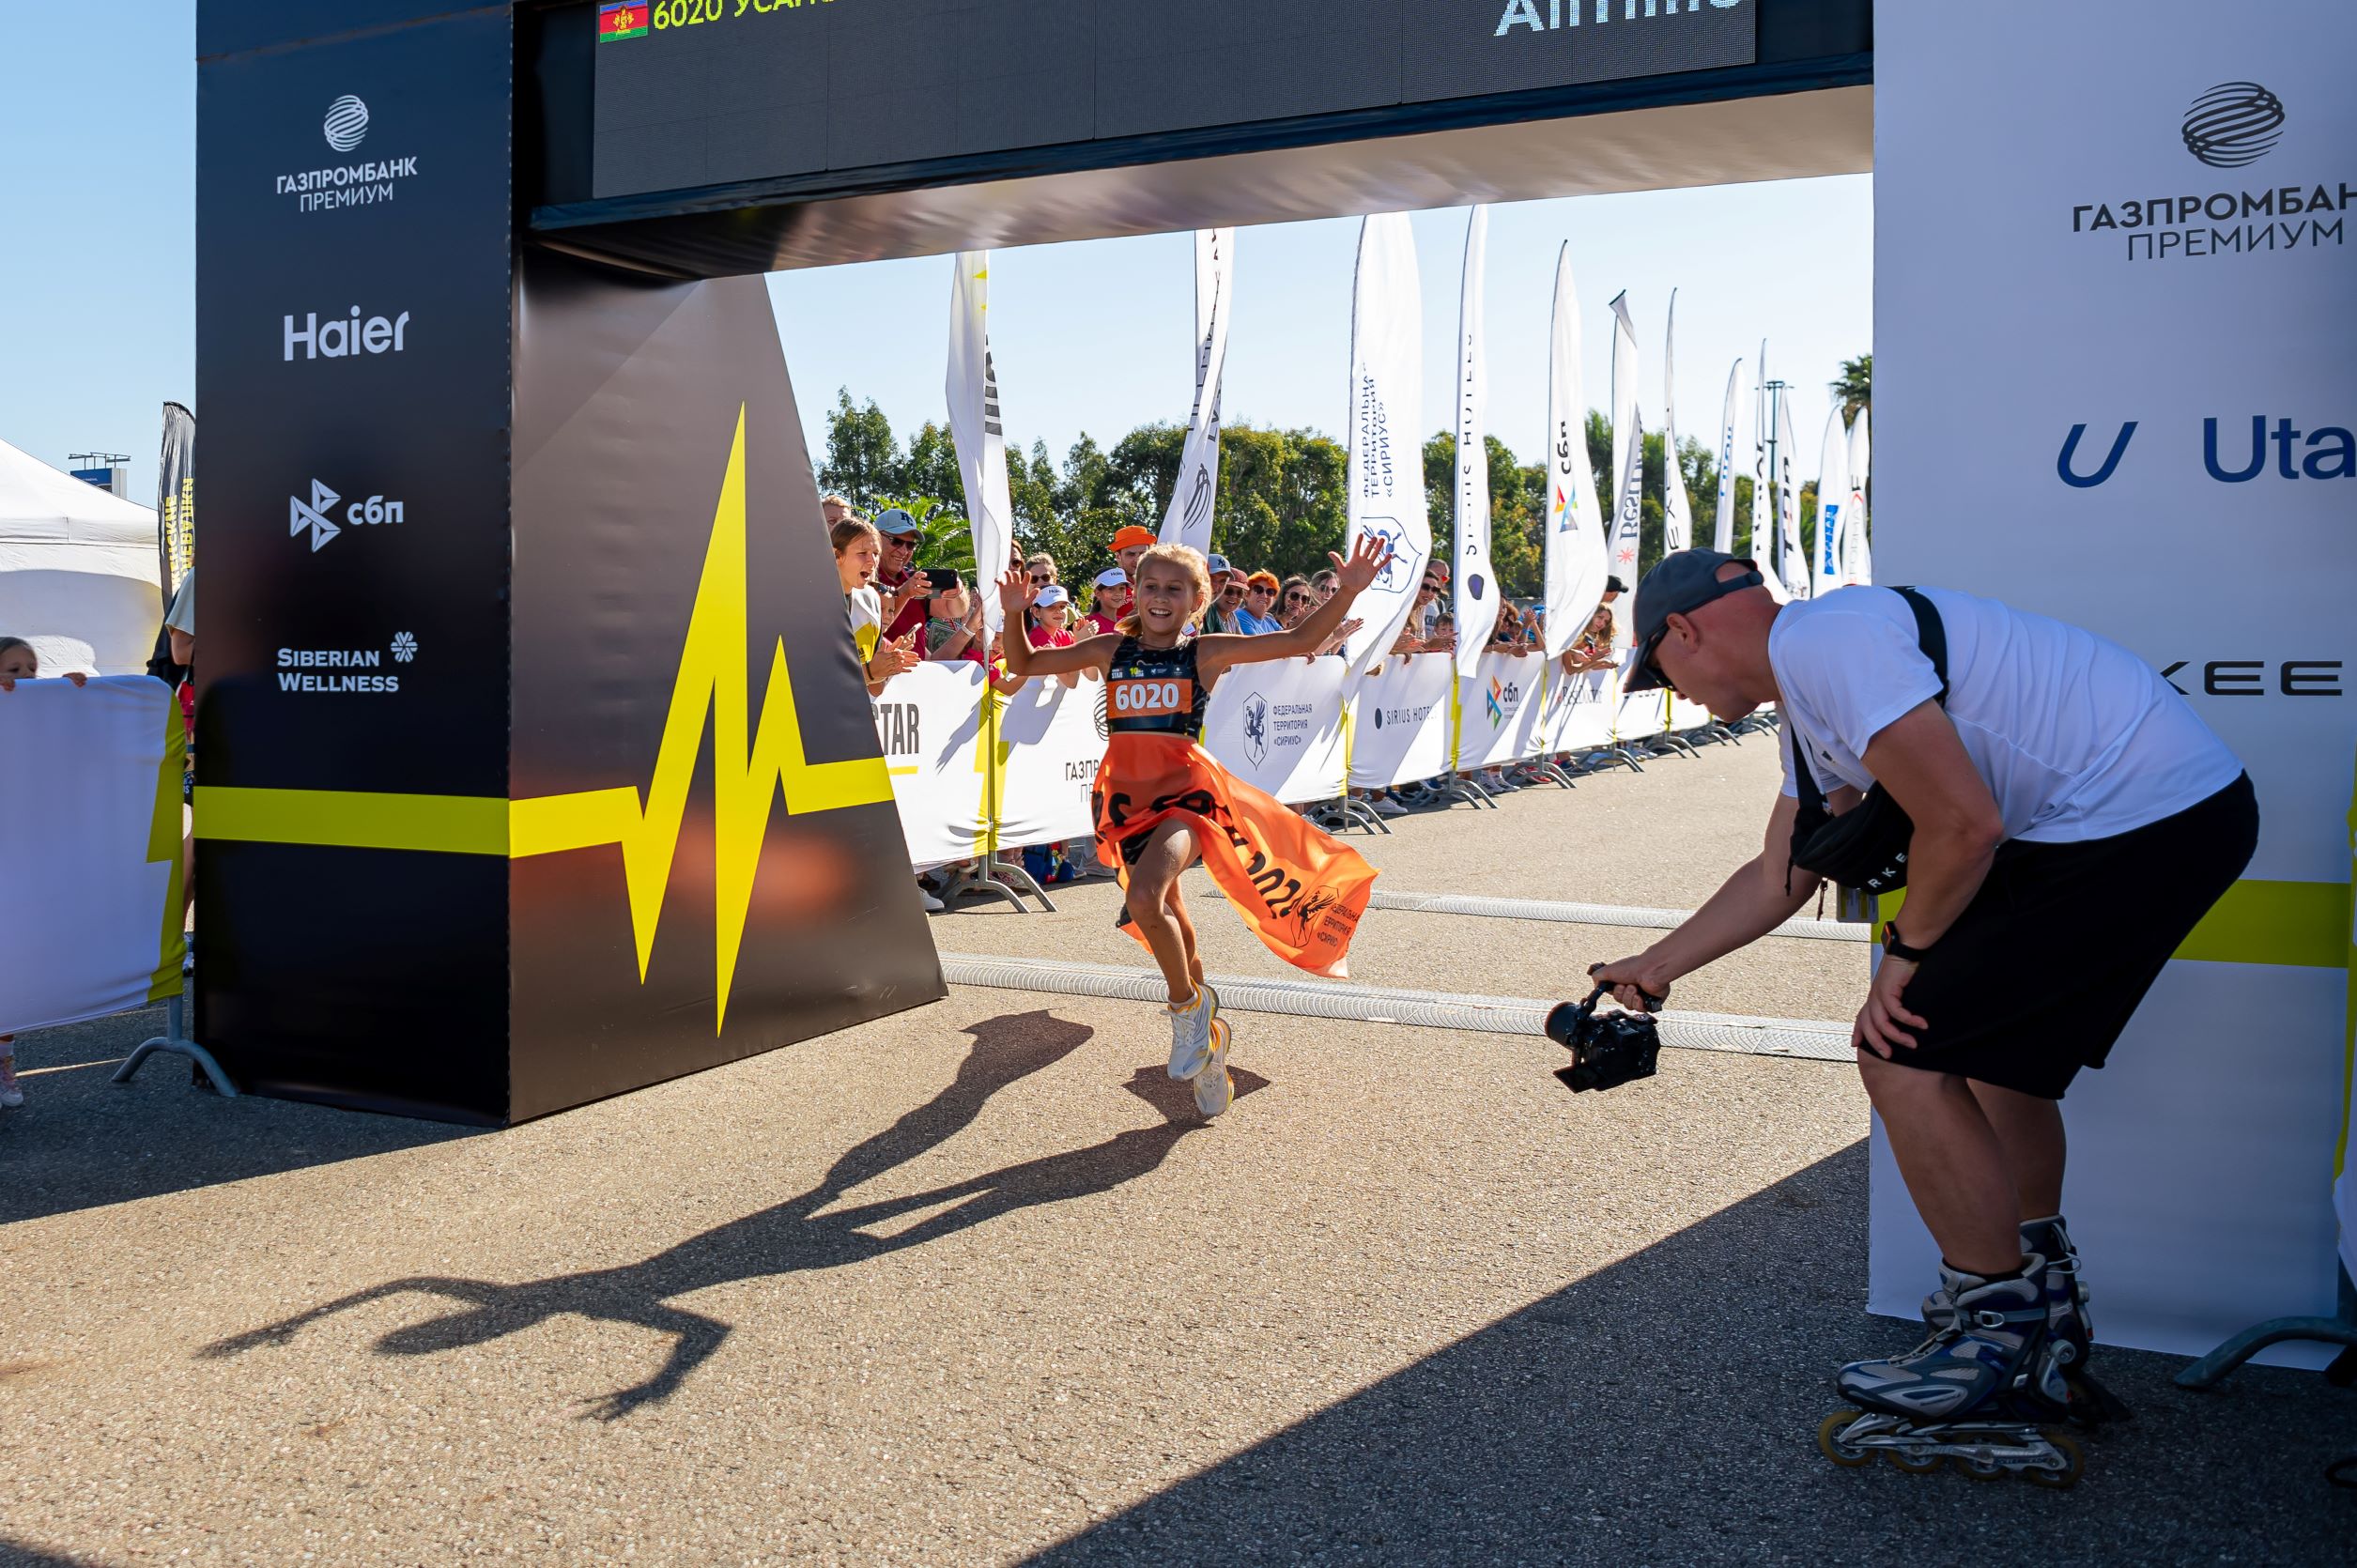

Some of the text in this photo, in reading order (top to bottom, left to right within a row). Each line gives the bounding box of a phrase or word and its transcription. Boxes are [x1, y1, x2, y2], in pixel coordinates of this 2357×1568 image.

[654, 0, 722, 29] 6020
[276, 156, 418, 194] ГАЗПРОМБАНК
[300, 182, 393, 213] ПРЕМИУМ
[2127, 217, 2344, 261] ПРЕМИУМ
[284, 305, 410, 361] Haier
[347, 495, 405, 526] сбп
[1115, 683, 1179, 711] 6020
[1502, 682, 1518, 702] сбп
[1272, 703, 1313, 716] ФЕДЕРАЛЬНАЯ
[1386, 708, 1410, 725] SIRIUS
[871, 702, 919, 755] TAR
[1272, 719, 1308, 730] ТЕРРИТОРИЯ
[1273, 735, 1302, 746] «СИРИУС»
